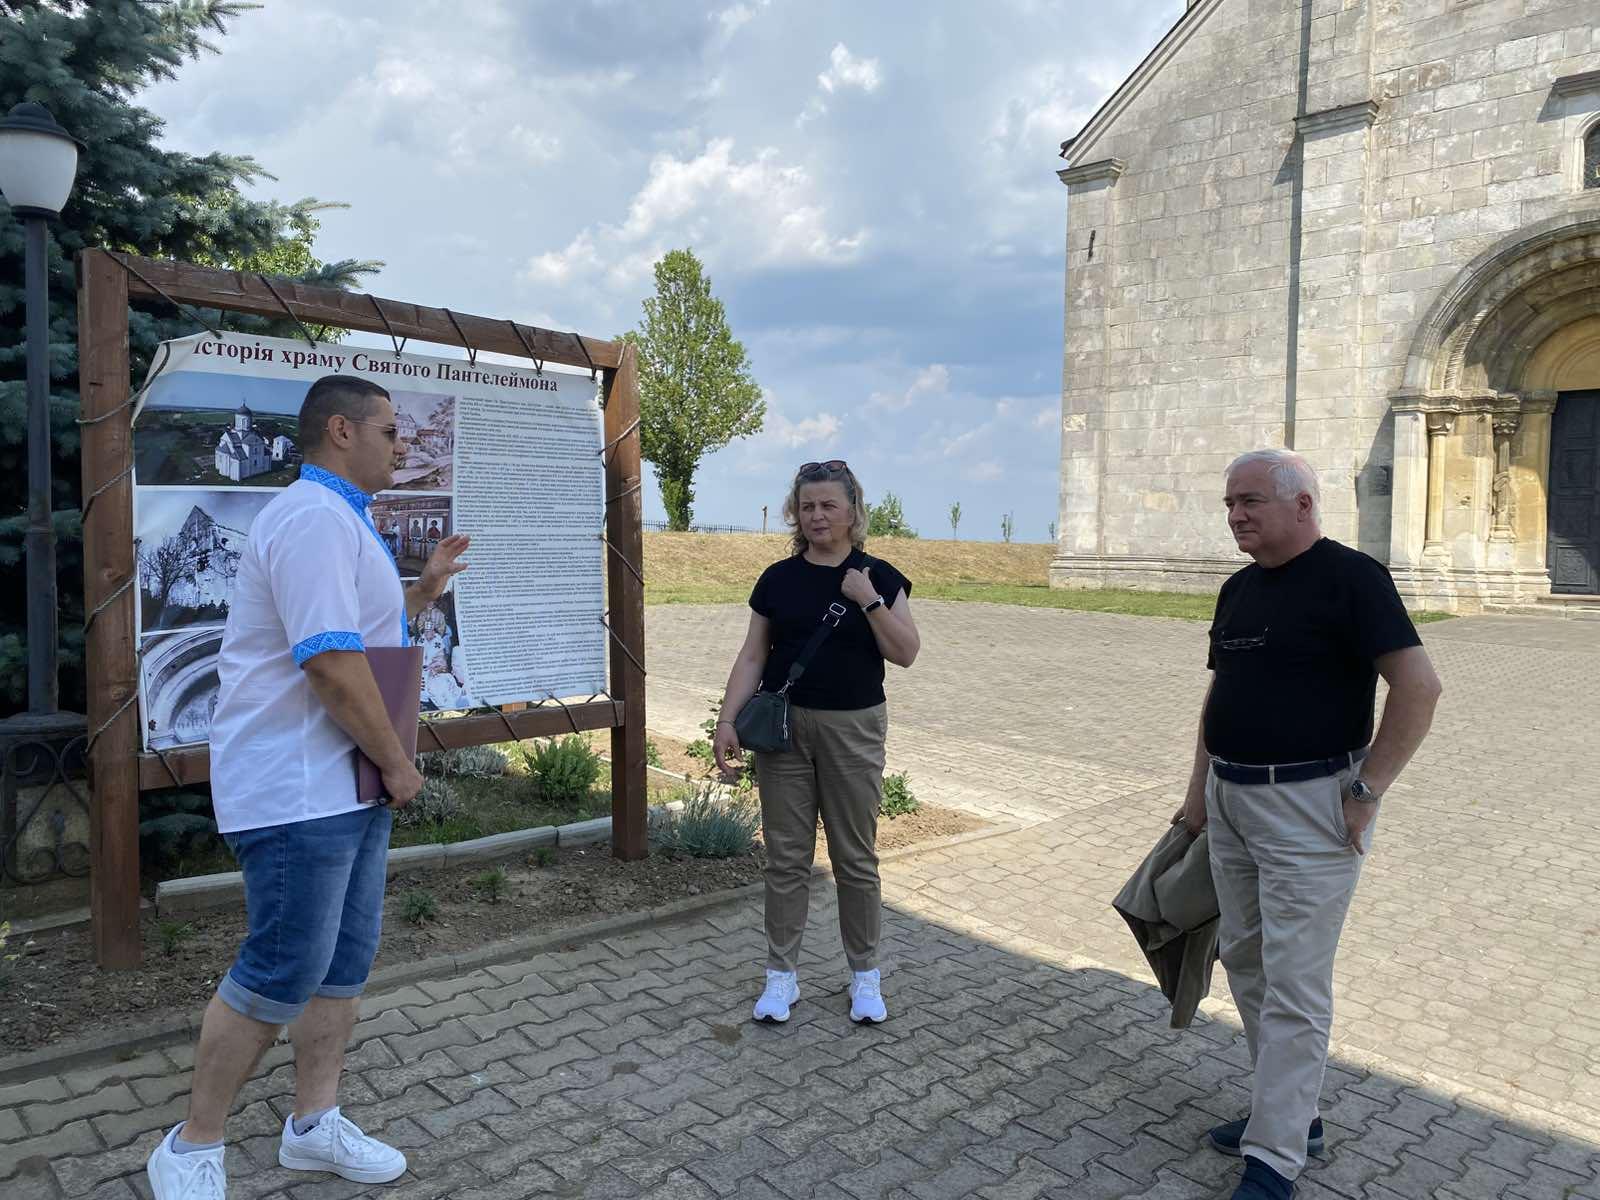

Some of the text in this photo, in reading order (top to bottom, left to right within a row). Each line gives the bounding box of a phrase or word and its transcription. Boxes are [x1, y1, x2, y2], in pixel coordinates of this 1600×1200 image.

[280, 350, 346, 373] храму
[352, 353, 431, 378] Святого
[436, 364, 559, 392] Пантелеймона
